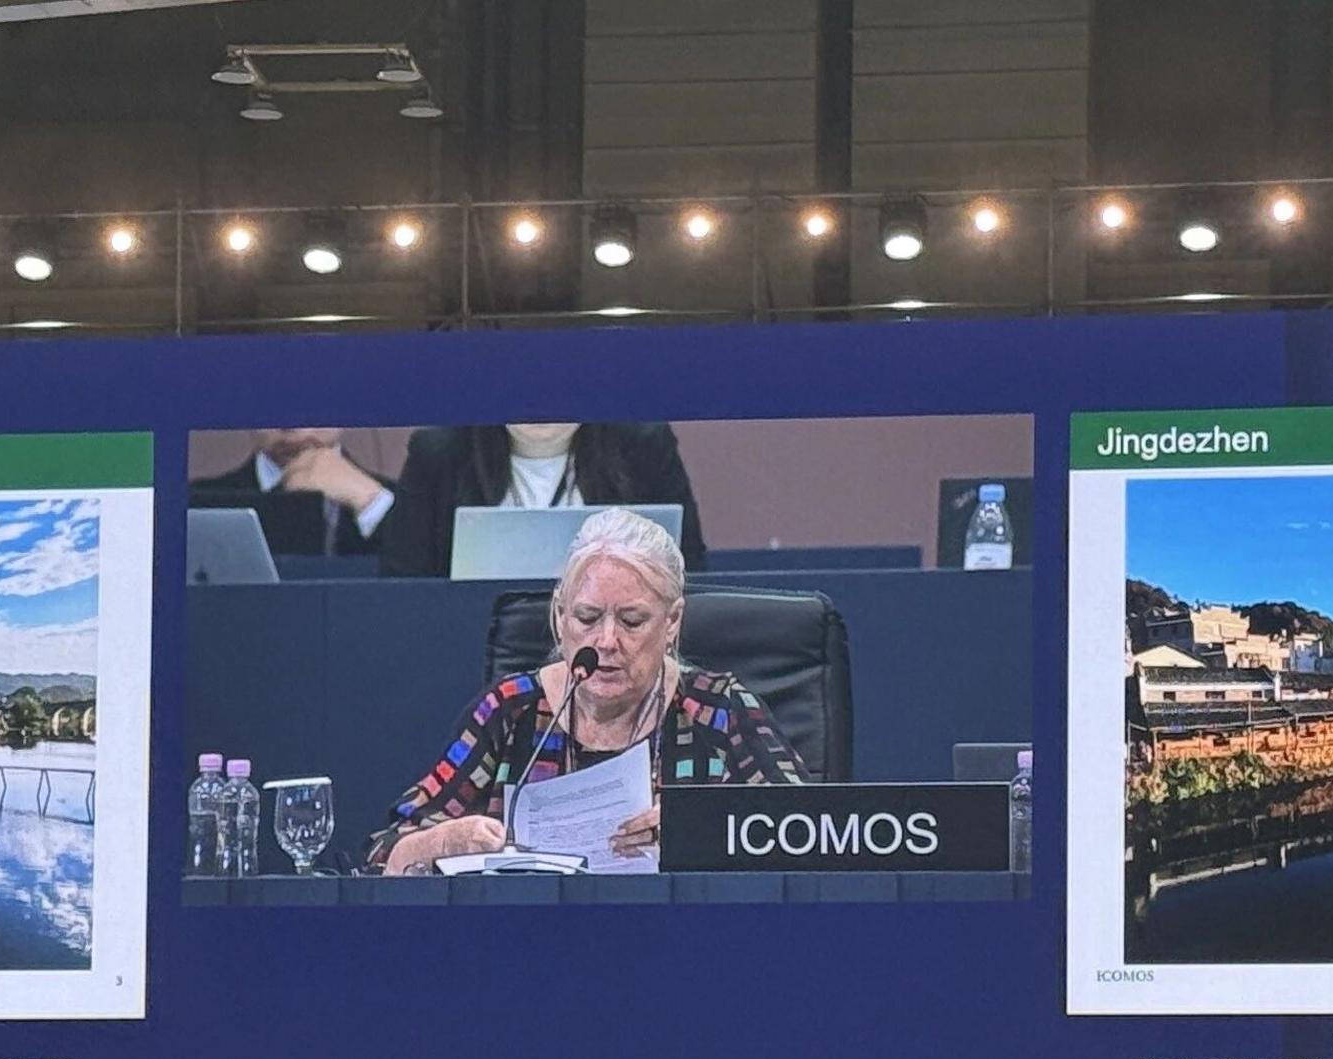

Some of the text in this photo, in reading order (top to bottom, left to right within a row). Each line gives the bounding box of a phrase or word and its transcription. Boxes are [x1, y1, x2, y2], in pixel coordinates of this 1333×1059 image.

[1097, 425, 1269, 461] Jingdezhen
[726, 812, 939, 856] ICOMOS
[1096, 969, 1155, 983] ICOMOS
